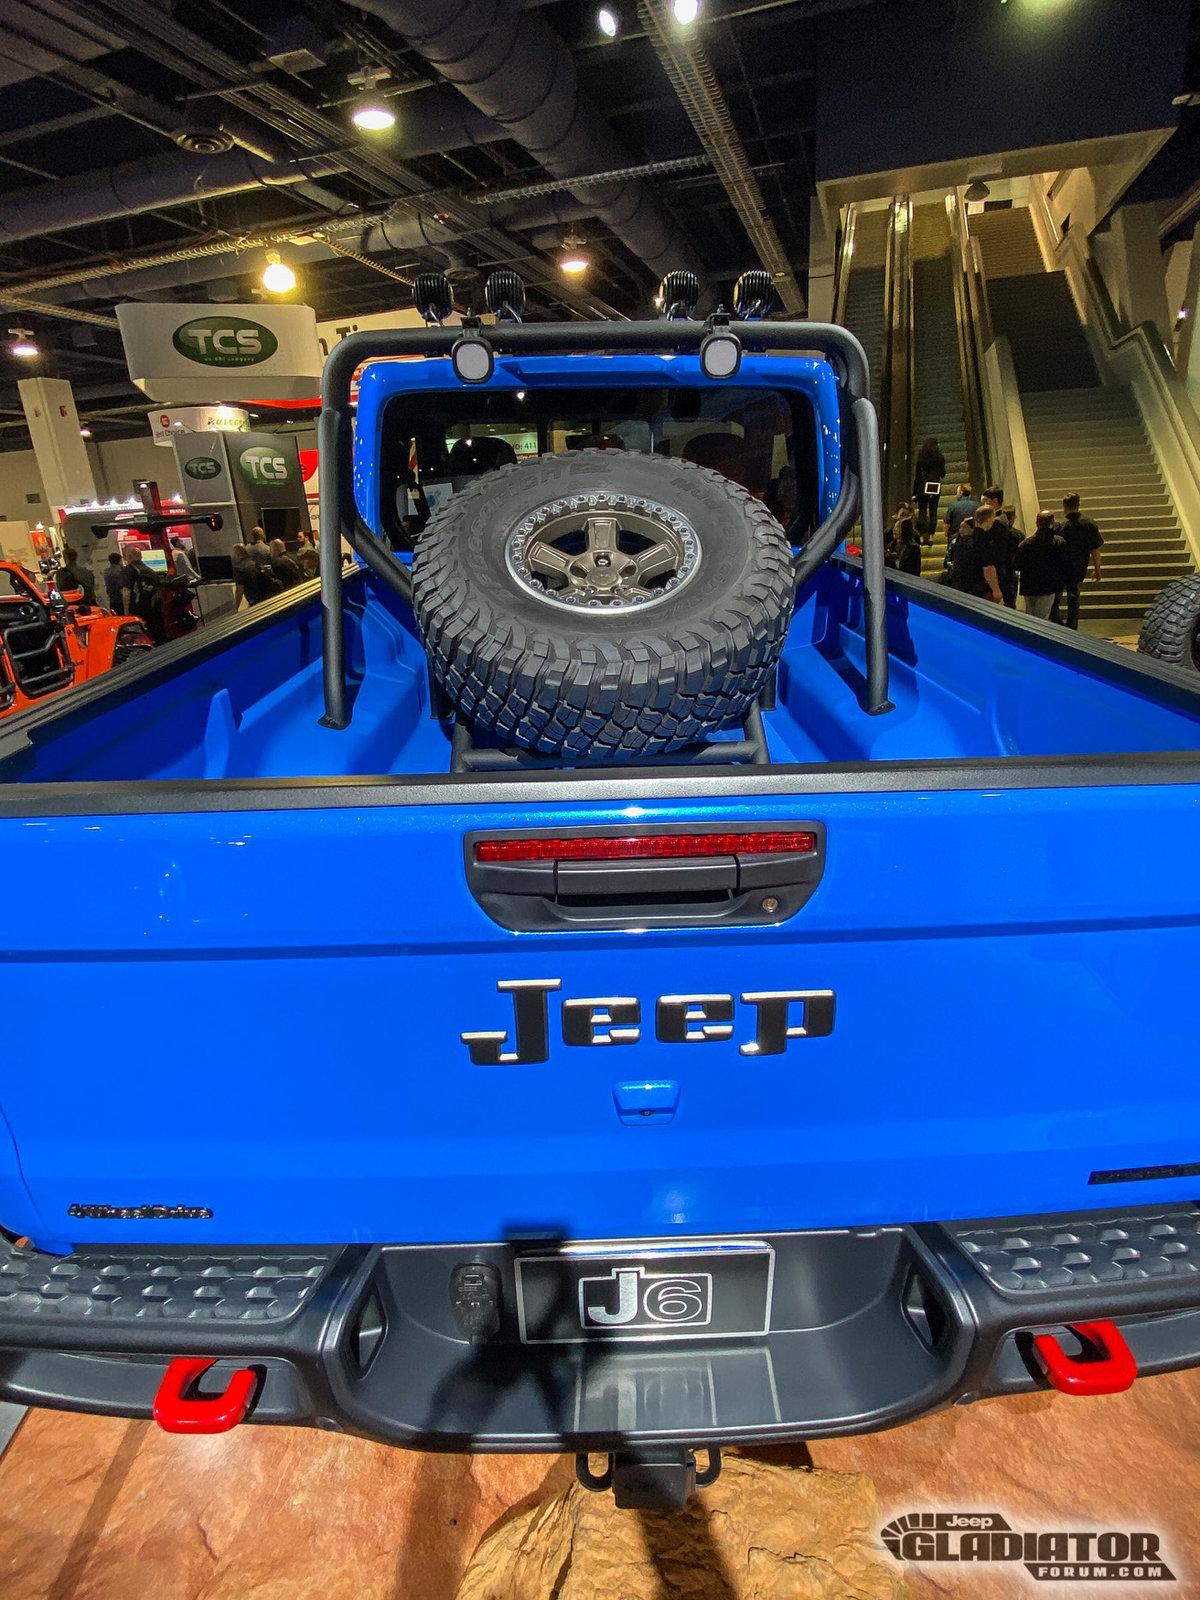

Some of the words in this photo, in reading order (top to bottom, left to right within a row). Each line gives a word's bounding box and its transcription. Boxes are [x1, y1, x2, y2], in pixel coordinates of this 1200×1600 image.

[188, 329, 262, 355] TCS
[188, 462, 216, 475] TCS
[246, 456, 288, 479] TCS
[460, 978, 837, 1066] Jeep
[587, 1271, 703, 1325] J6
